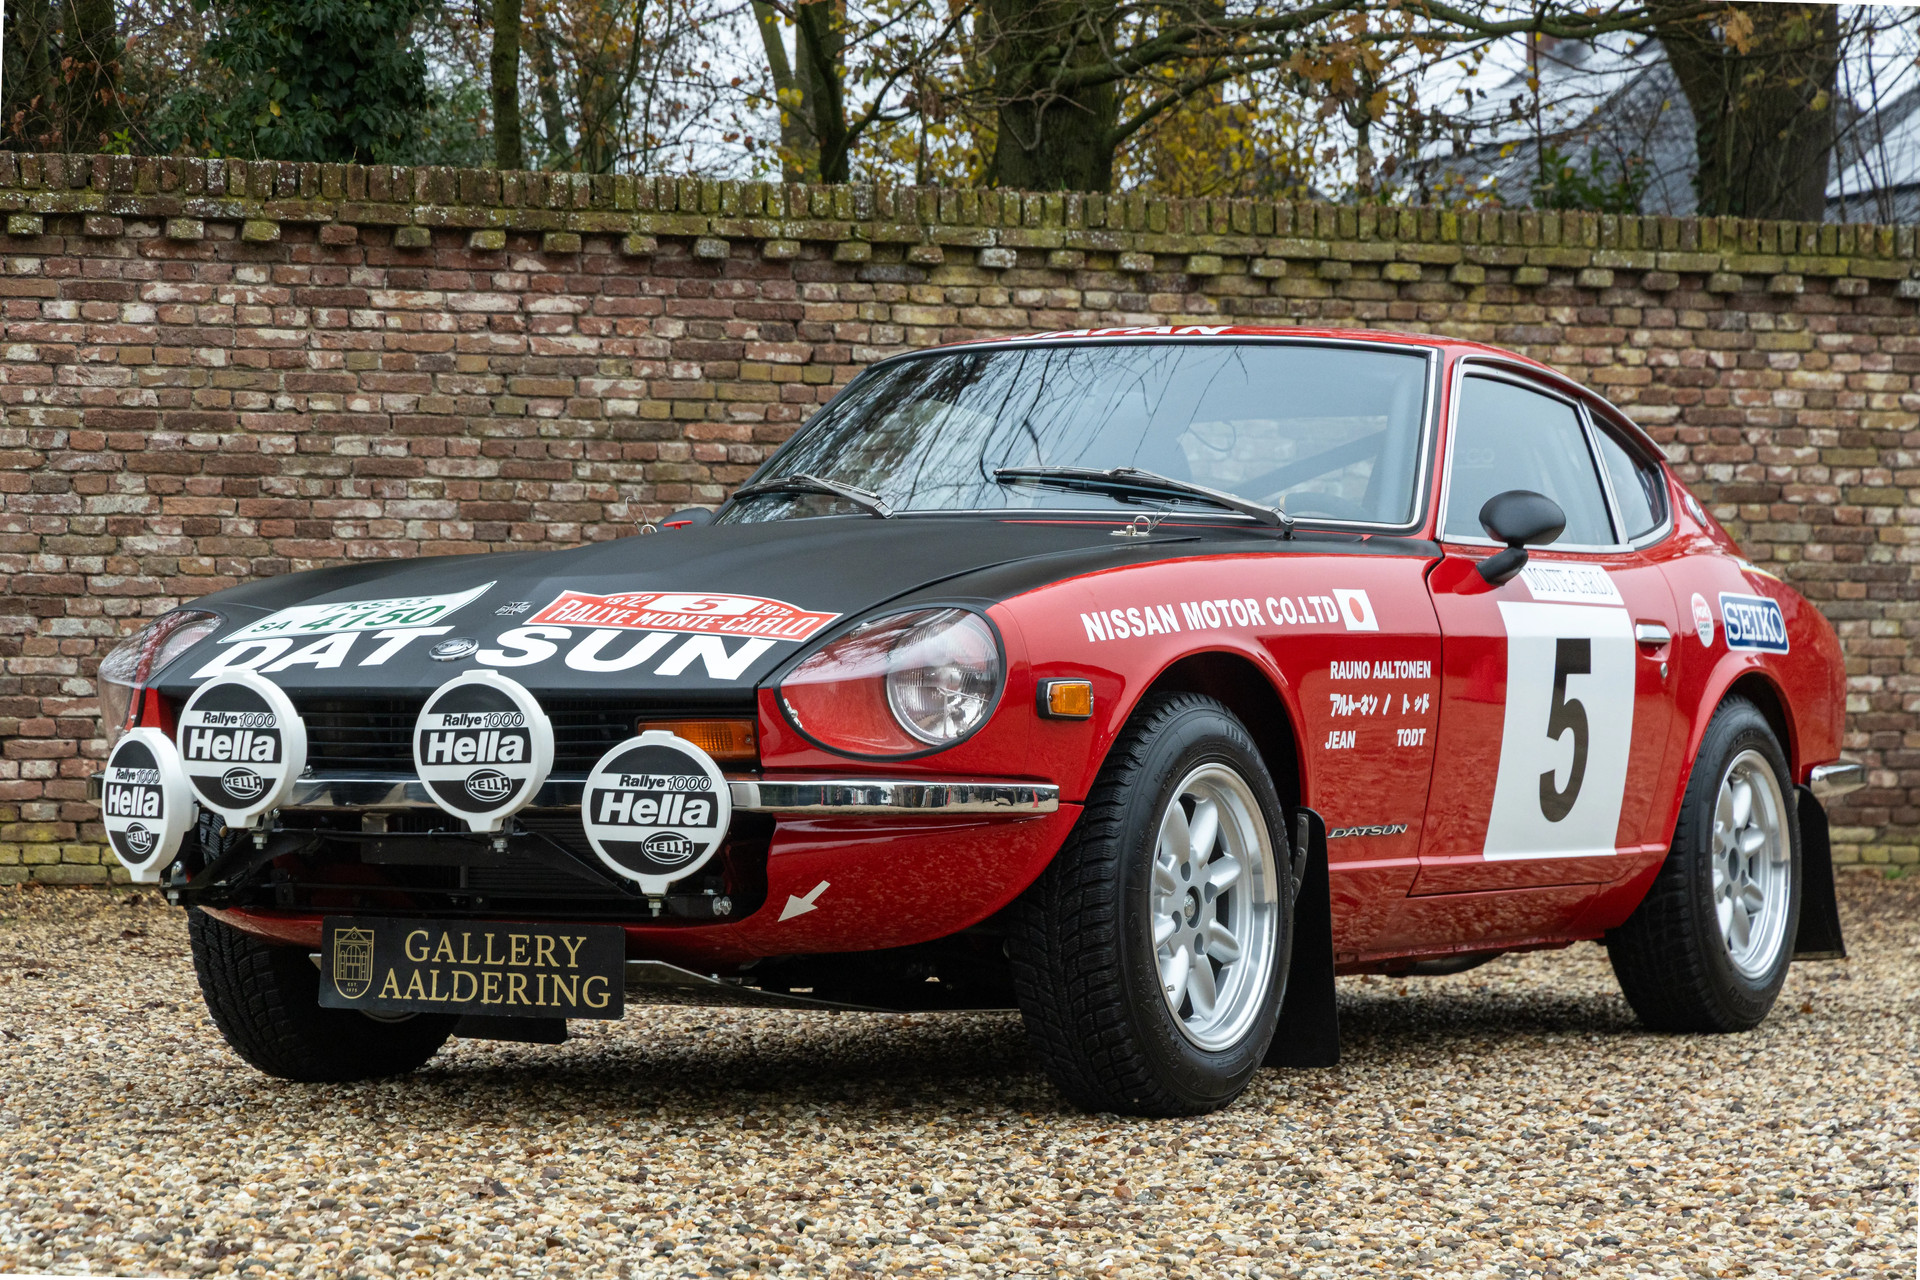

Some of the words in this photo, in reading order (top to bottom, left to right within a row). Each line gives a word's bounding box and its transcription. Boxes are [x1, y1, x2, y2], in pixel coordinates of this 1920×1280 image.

[603, 595, 655, 608] 1972
[681, 598, 729, 611] 5
[251, 620, 292, 633] SA
[299, 605, 446, 631] 4150
[554, 598, 638, 624] RALLYE
[630, 612, 820, 637] MONTE-CARLO
[1080, 604, 1180, 642] NISSAN
[1180, 599, 1266, 631] MOTOR
[1265, 596, 1339, 625] CO.LTD
[1724, 602, 1785, 645] SEIKO
[189, 625, 455, 679] DAT
[475, 625, 777, 681] SUN
[1330, 661, 1370, 679] RAUNO
[1373, 660, 1431, 679] AALTONEN
[203, 712, 238, 726] Rallye
[239, 712, 277, 728] 1000
[442, 713, 482, 727] Rallye
[483, 712, 525, 727] 1000
[1539, 638, 1591, 822] 5
[188, 728, 277, 762] Hella
[427, 730, 524, 763] Hella
[1325, 730, 1356, 749] JEAN
[1397, 728, 1427, 747] TODT
[115, 768, 136, 781] Rallye
[136, 769, 161, 784] 1000
[224, 775, 263, 791] HELLA
[468, 776, 511, 791] HELLA
[619, 774, 666, 789] Rallye
[667, 775, 712, 791] 1000
[107, 785, 159, 817] Hella
[599, 791, 711, 826] Hella
[126, 830, 151, 846] HELLA
[1327, 824, 1408, 838] DATSUN
[645, 839, 693, 855] HELLA
[404, 929, 587, 968] GALLERY
[378, 967, 611, 1008] AALDERING
